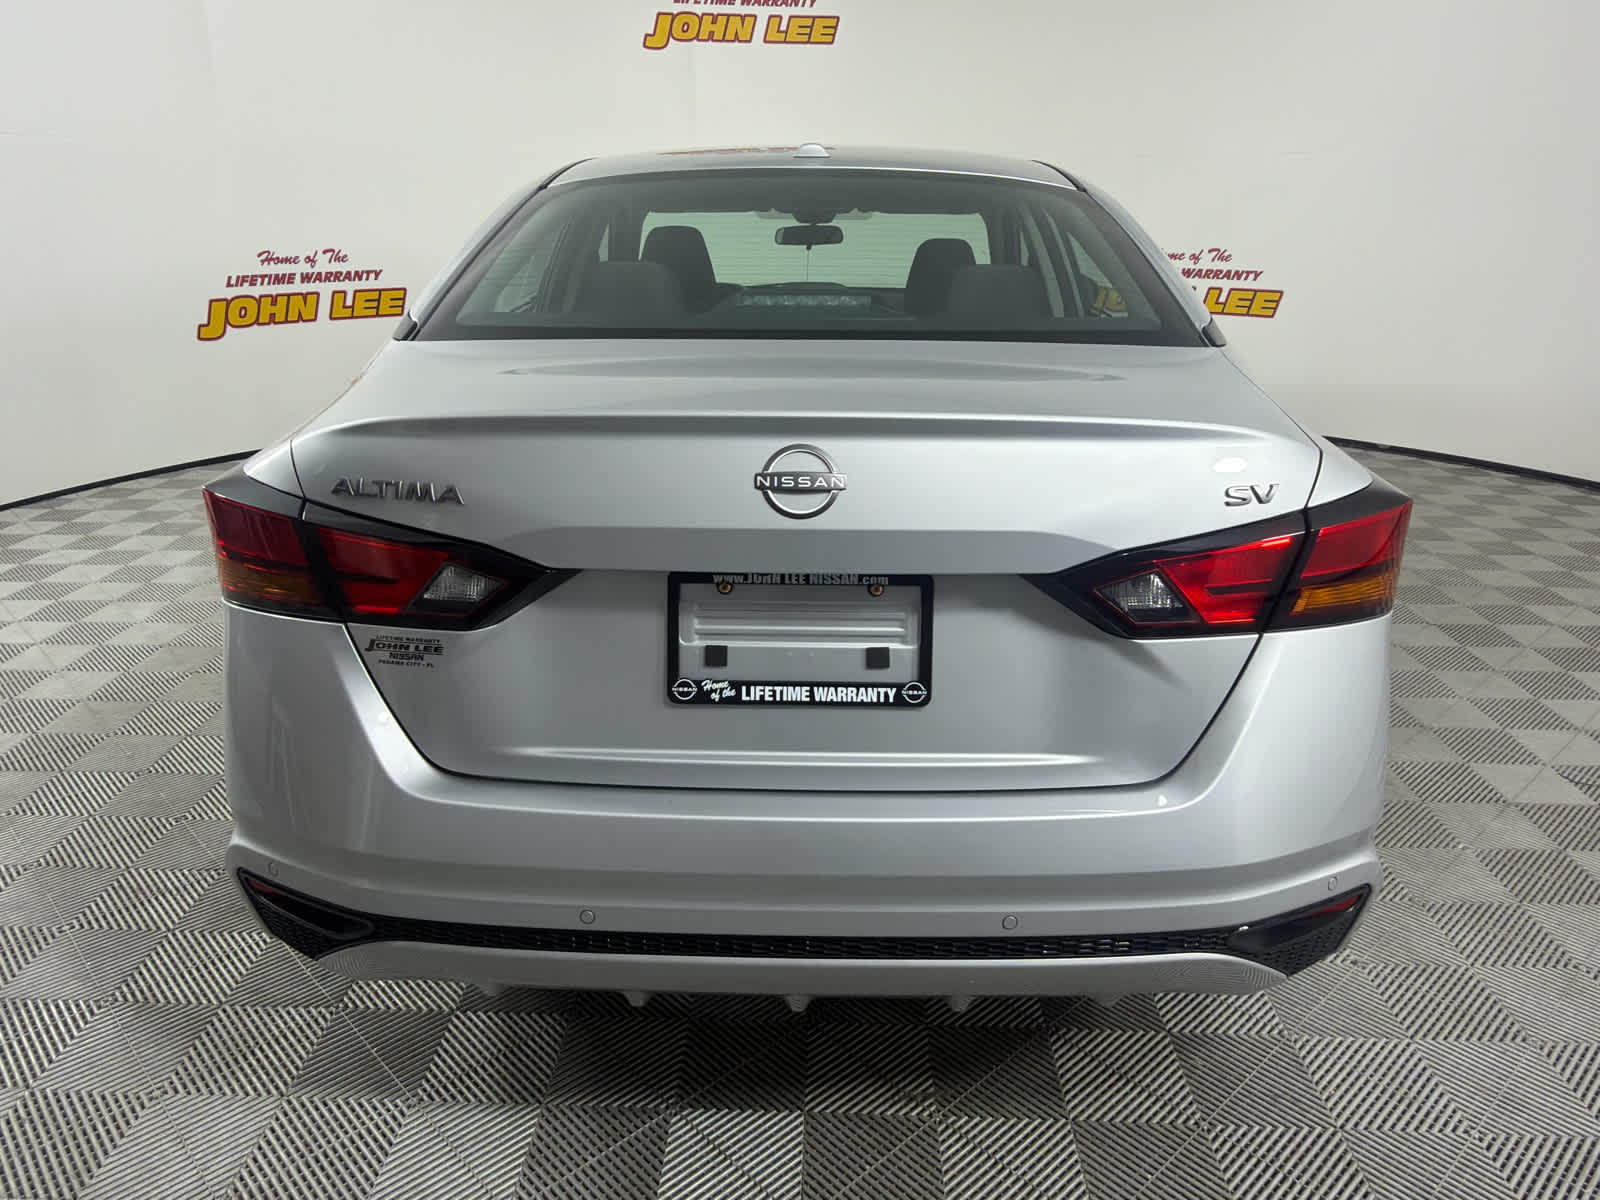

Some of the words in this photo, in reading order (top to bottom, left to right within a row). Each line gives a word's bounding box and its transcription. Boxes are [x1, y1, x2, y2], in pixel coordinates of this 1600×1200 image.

[740, 0, 817, 8] WARRANTY
[643, 11, 757, 50] JOHN
[763, 14, 840, 44] LEE
[257, 250, 300, 266] Home
[304, 251, 318, 268] of
[322, 248, 349, 264] The
[1189, 249, 1204, 265] of
[1207, 247, 1233, 263] The
[225, 273, 295, 288] LIFETIME
[299, 269, 383, 284] WARRANTY
[1181, 267, 1265, 282] WARRANTY
[1203, 286, 1284, 319] LEE
[197, 292, 320, 341] JOHN
[329, 287, 407, 320] LEE
[756, 475, 845, 488] NISSAN
[331, 477, 464, 505] ALTIMA
[1224, 483, 1280, 507] SV
[784, 573, 806, 584] LEE
[364, 638, 410, 652] JOHN
[414, 645, 444, 653] LEE
[389, 652, 425, 661] NISSAN
[701, 680, 729, 691] Home
[711, 689, 720, 702] of
[722, 687, 736, 698] the
[741, 685, 810, 702] LIFETIME
[813, 686, 897, 703] WARRANTY
